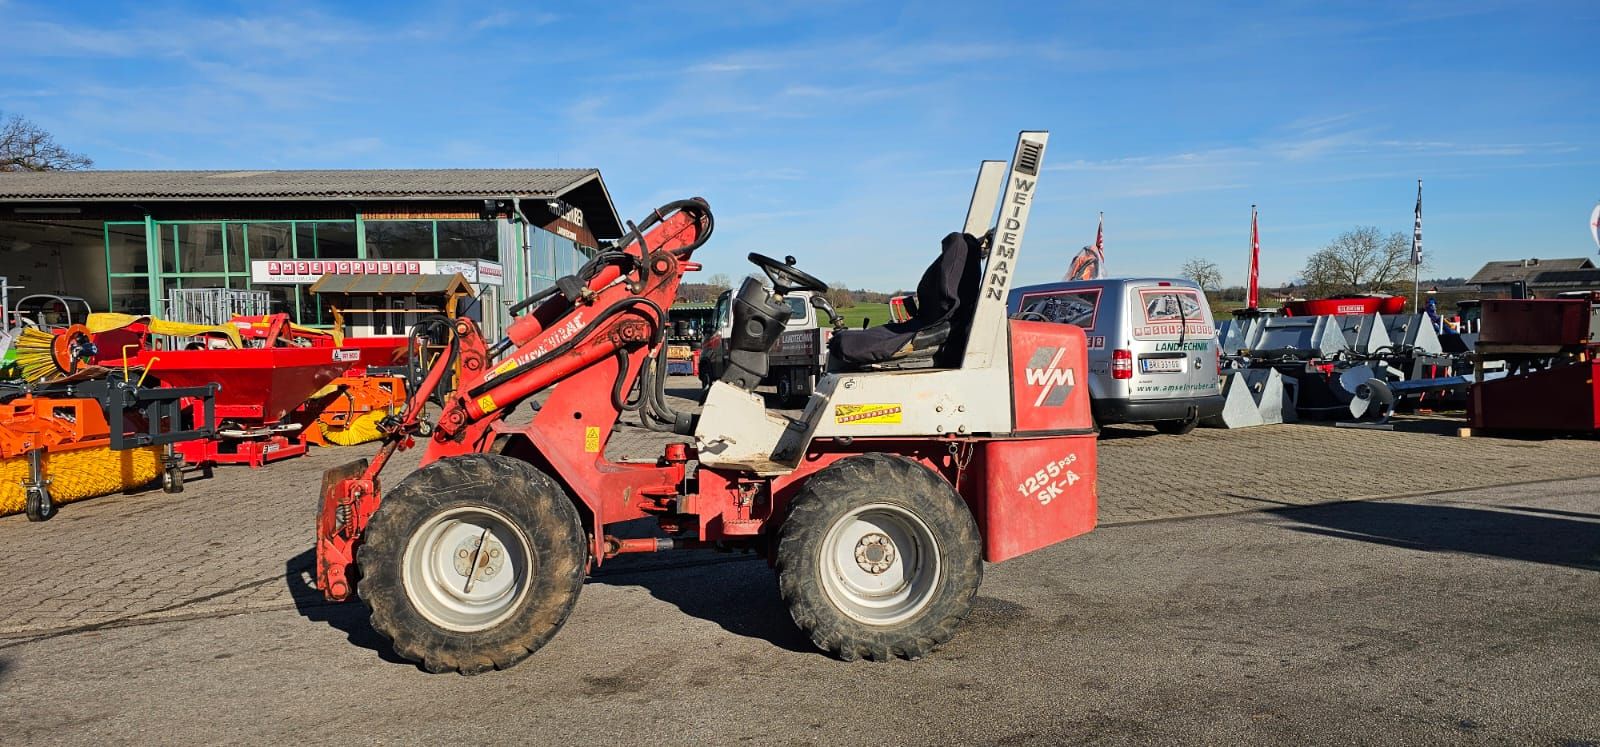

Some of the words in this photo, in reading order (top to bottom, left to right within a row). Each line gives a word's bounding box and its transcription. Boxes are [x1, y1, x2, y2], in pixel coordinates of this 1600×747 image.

[987, 177, 1034, 301] WEIDEMANN
[268, 262, 418, 273] AMSELGRUBER
[1037, 470, 1081, 506] SK-A
